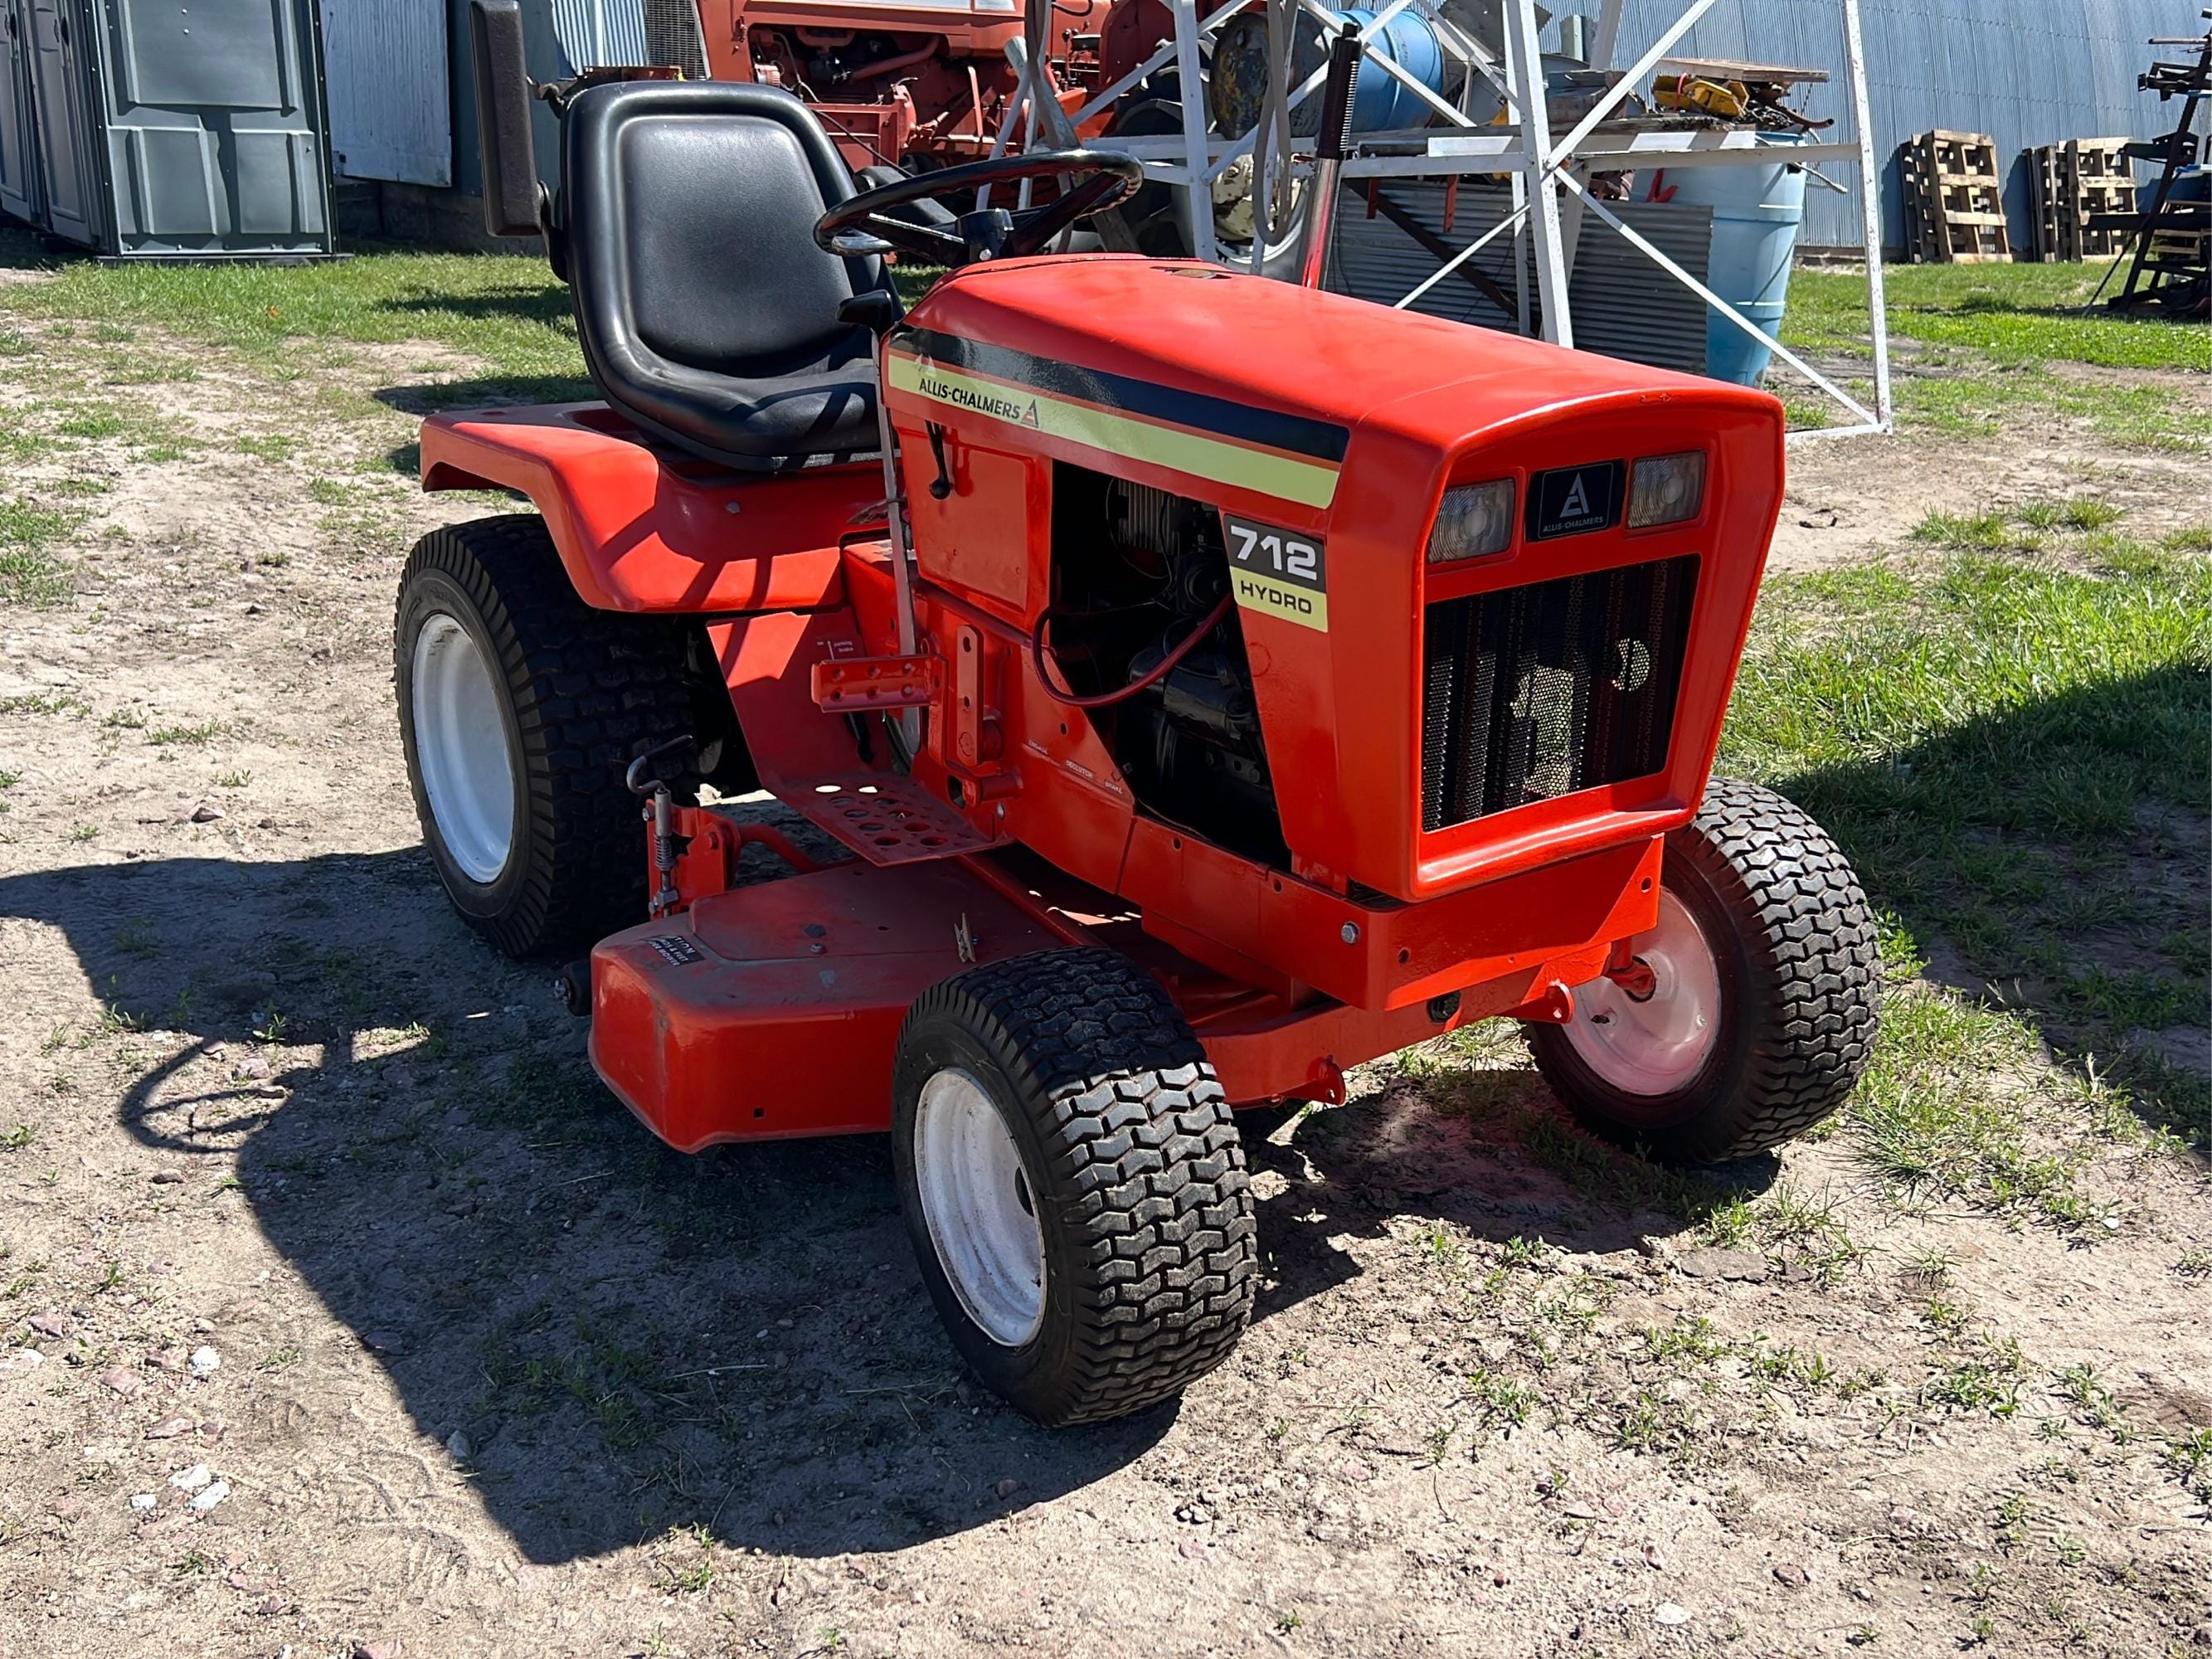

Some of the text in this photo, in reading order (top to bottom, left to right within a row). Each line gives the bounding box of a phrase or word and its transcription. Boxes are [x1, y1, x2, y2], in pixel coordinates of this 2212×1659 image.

[919, 378, 1021, 420] ALLIS-CHALMERS
[1543, 516, 1604, 533] ALLIS-CHALMERS
[1230, 524, 1317, 581] 712
[1241, 580, 1312, 615] HYDRO
[1066, 760, 1093, 778] DECLUTCH
